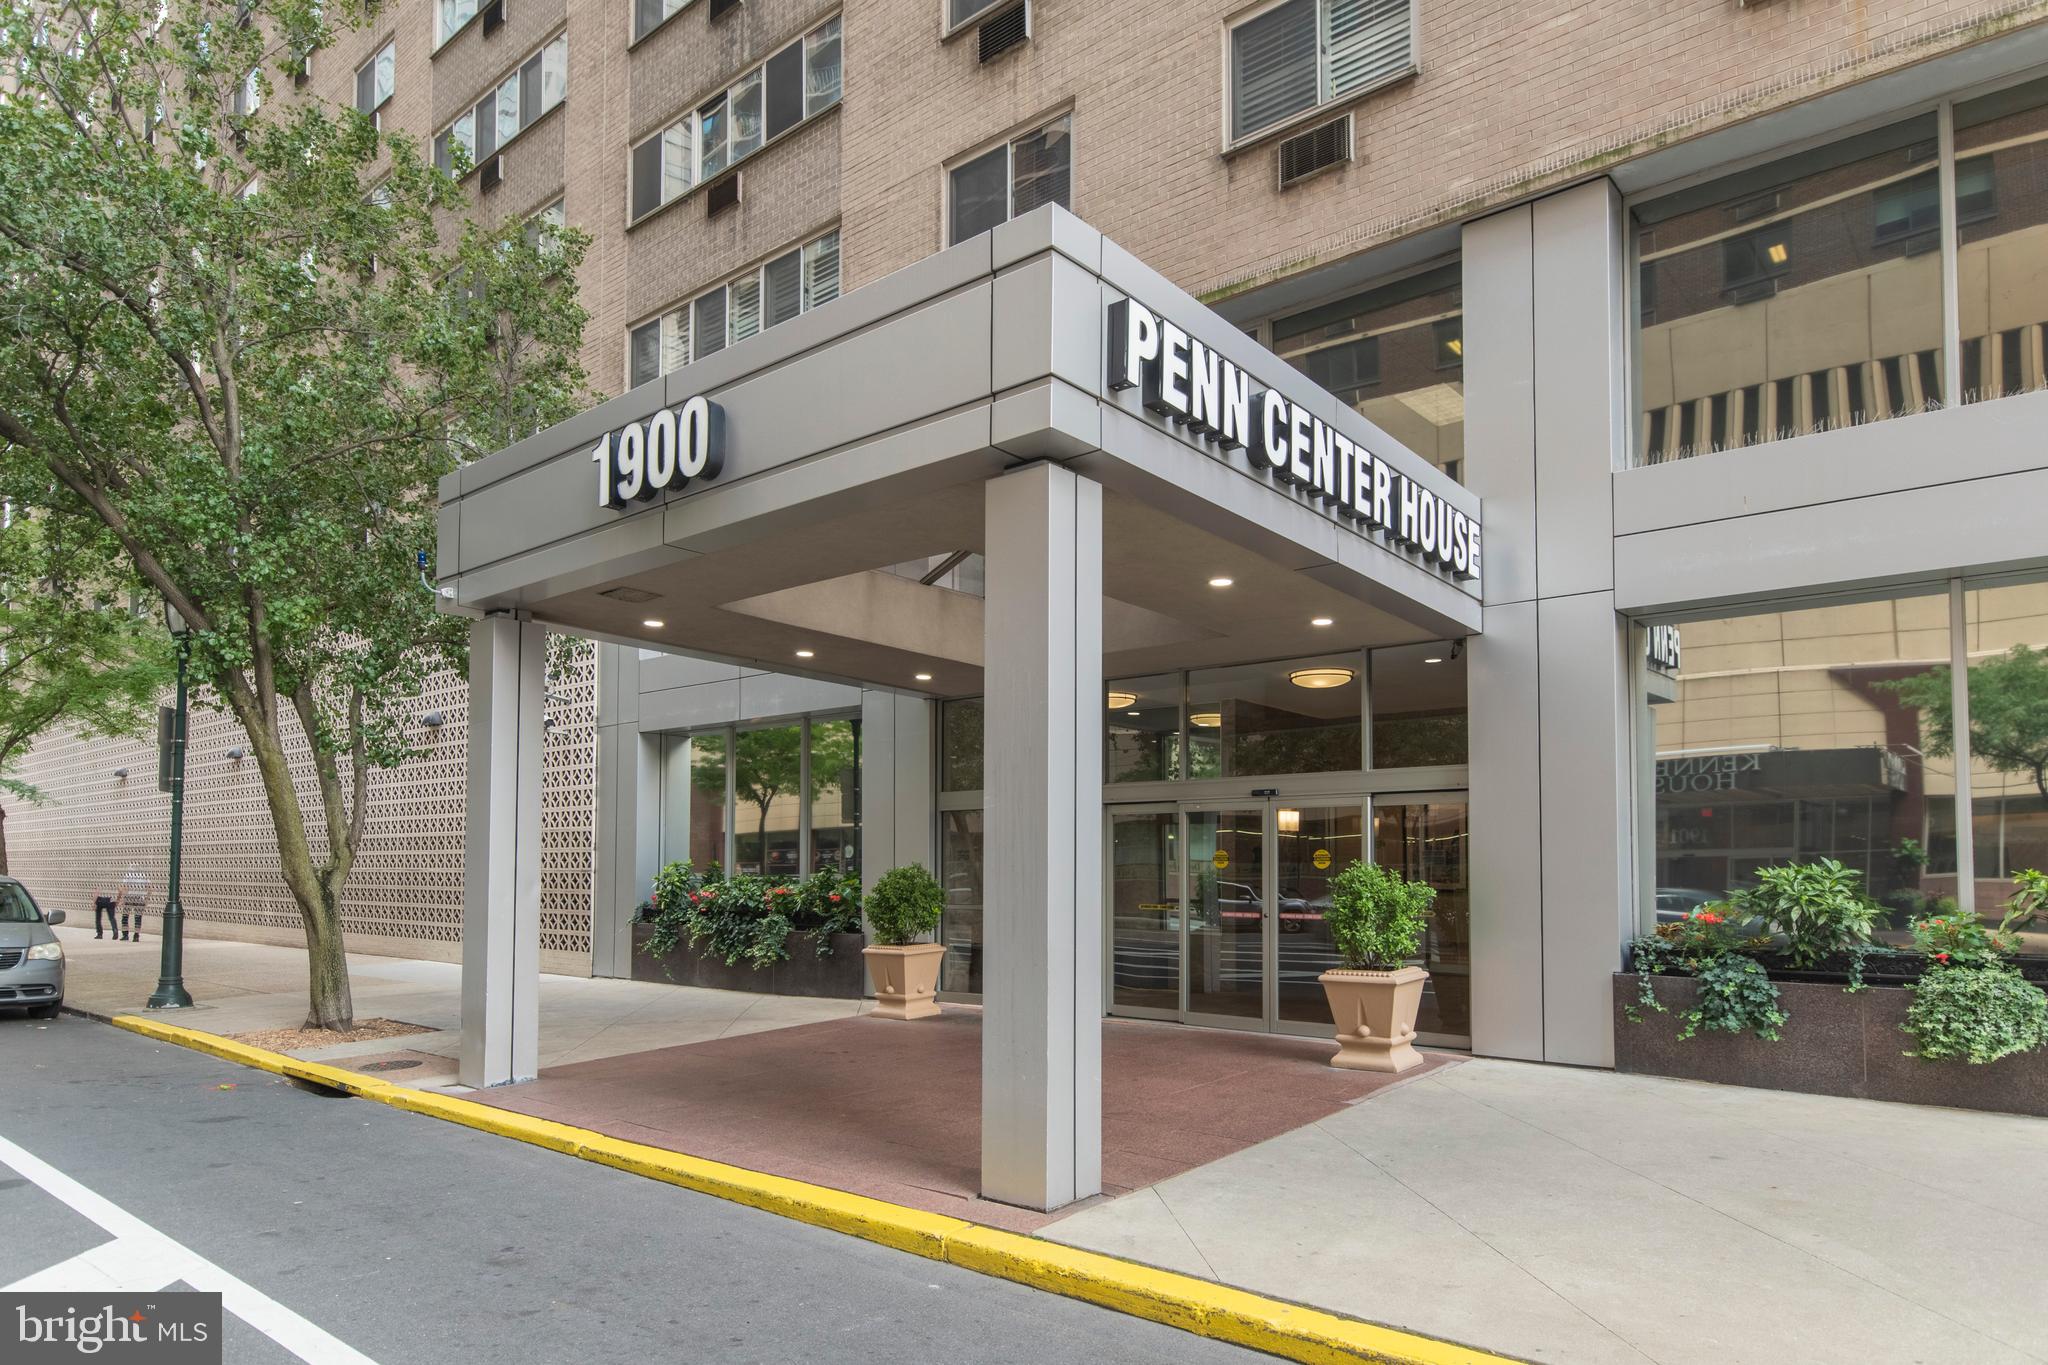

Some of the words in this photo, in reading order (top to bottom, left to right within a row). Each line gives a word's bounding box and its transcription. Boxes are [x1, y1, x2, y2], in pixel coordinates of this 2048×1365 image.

[591, 395, 709, 507] 1900
[1124, 296, 1250, 448] PENN
[1263, 388, 1392, 529] CENTER
[1401, 475, 1481, 580] HOUSE
